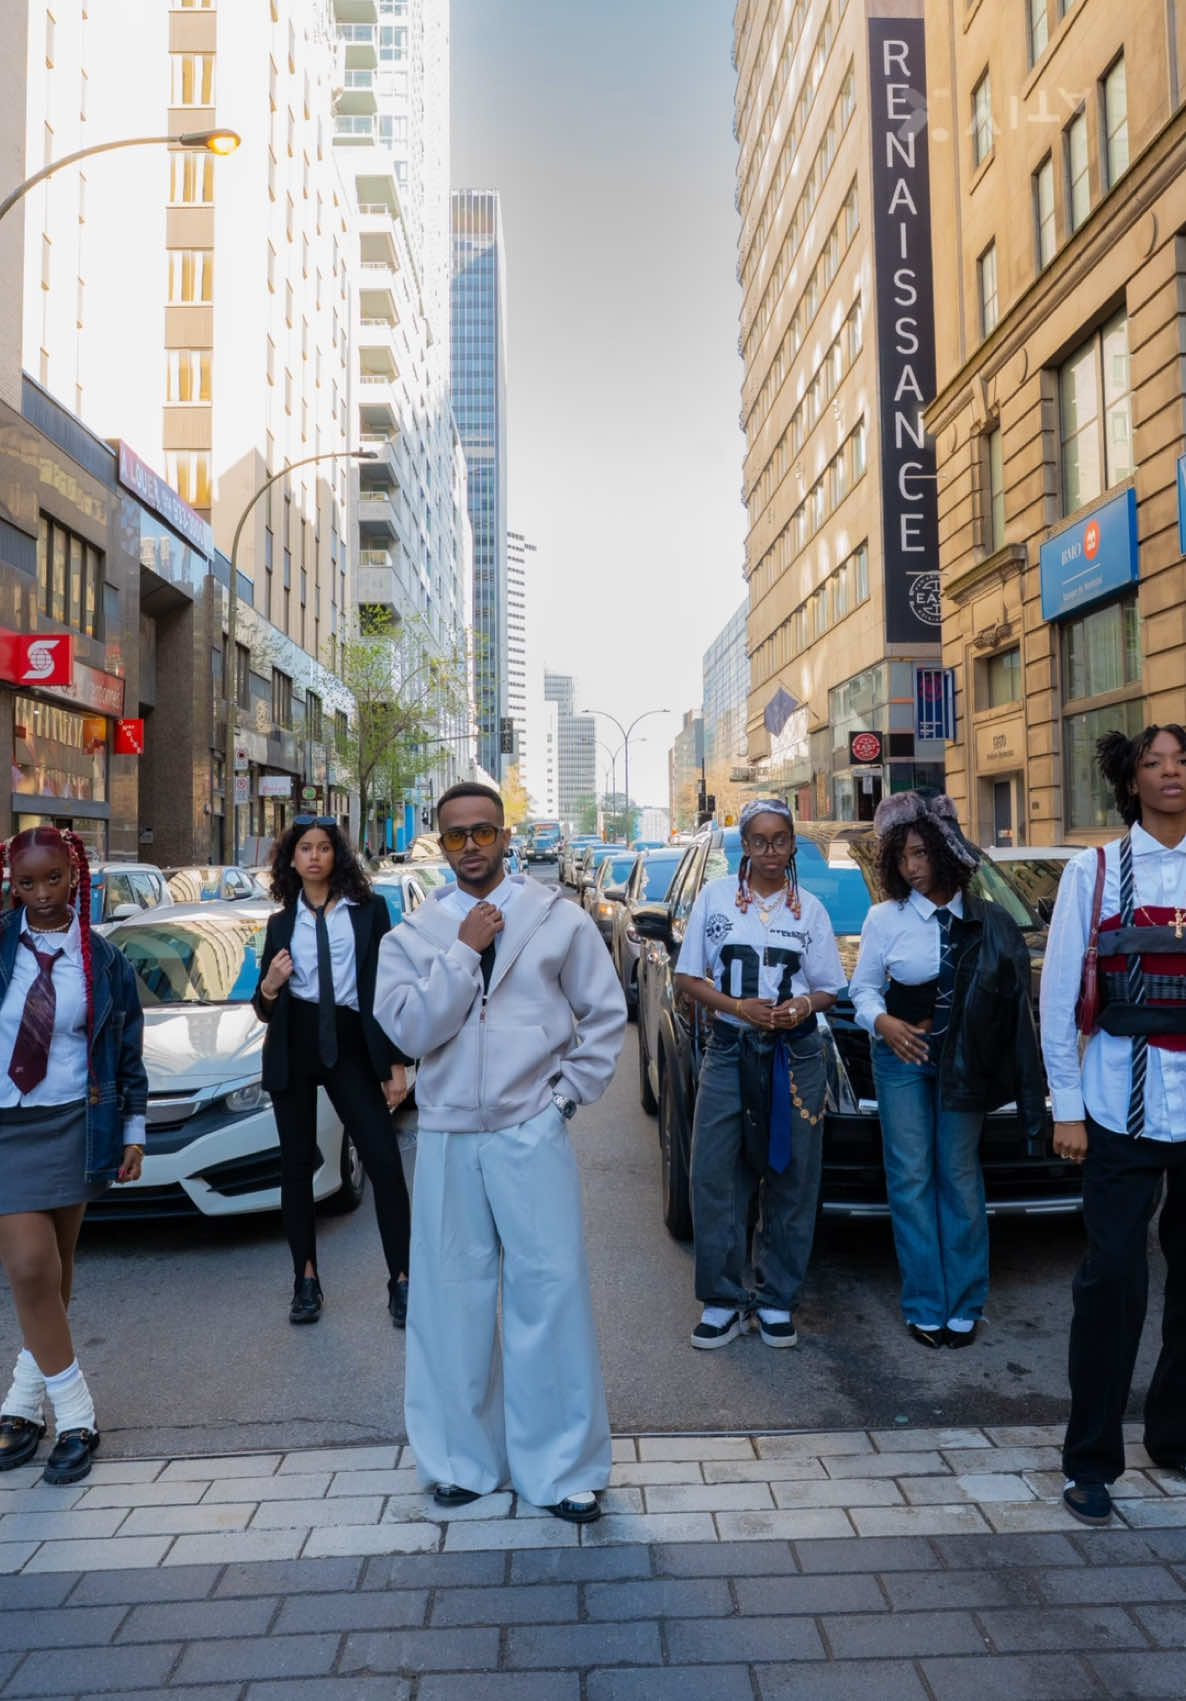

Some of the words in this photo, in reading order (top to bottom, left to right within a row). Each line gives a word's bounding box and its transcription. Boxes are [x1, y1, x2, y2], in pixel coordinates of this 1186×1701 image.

[883, 39, 926, 553] RENAISSANCE
[1061, 542, 1081, 567] BMO
[719, 943, 803, 1006] 07
